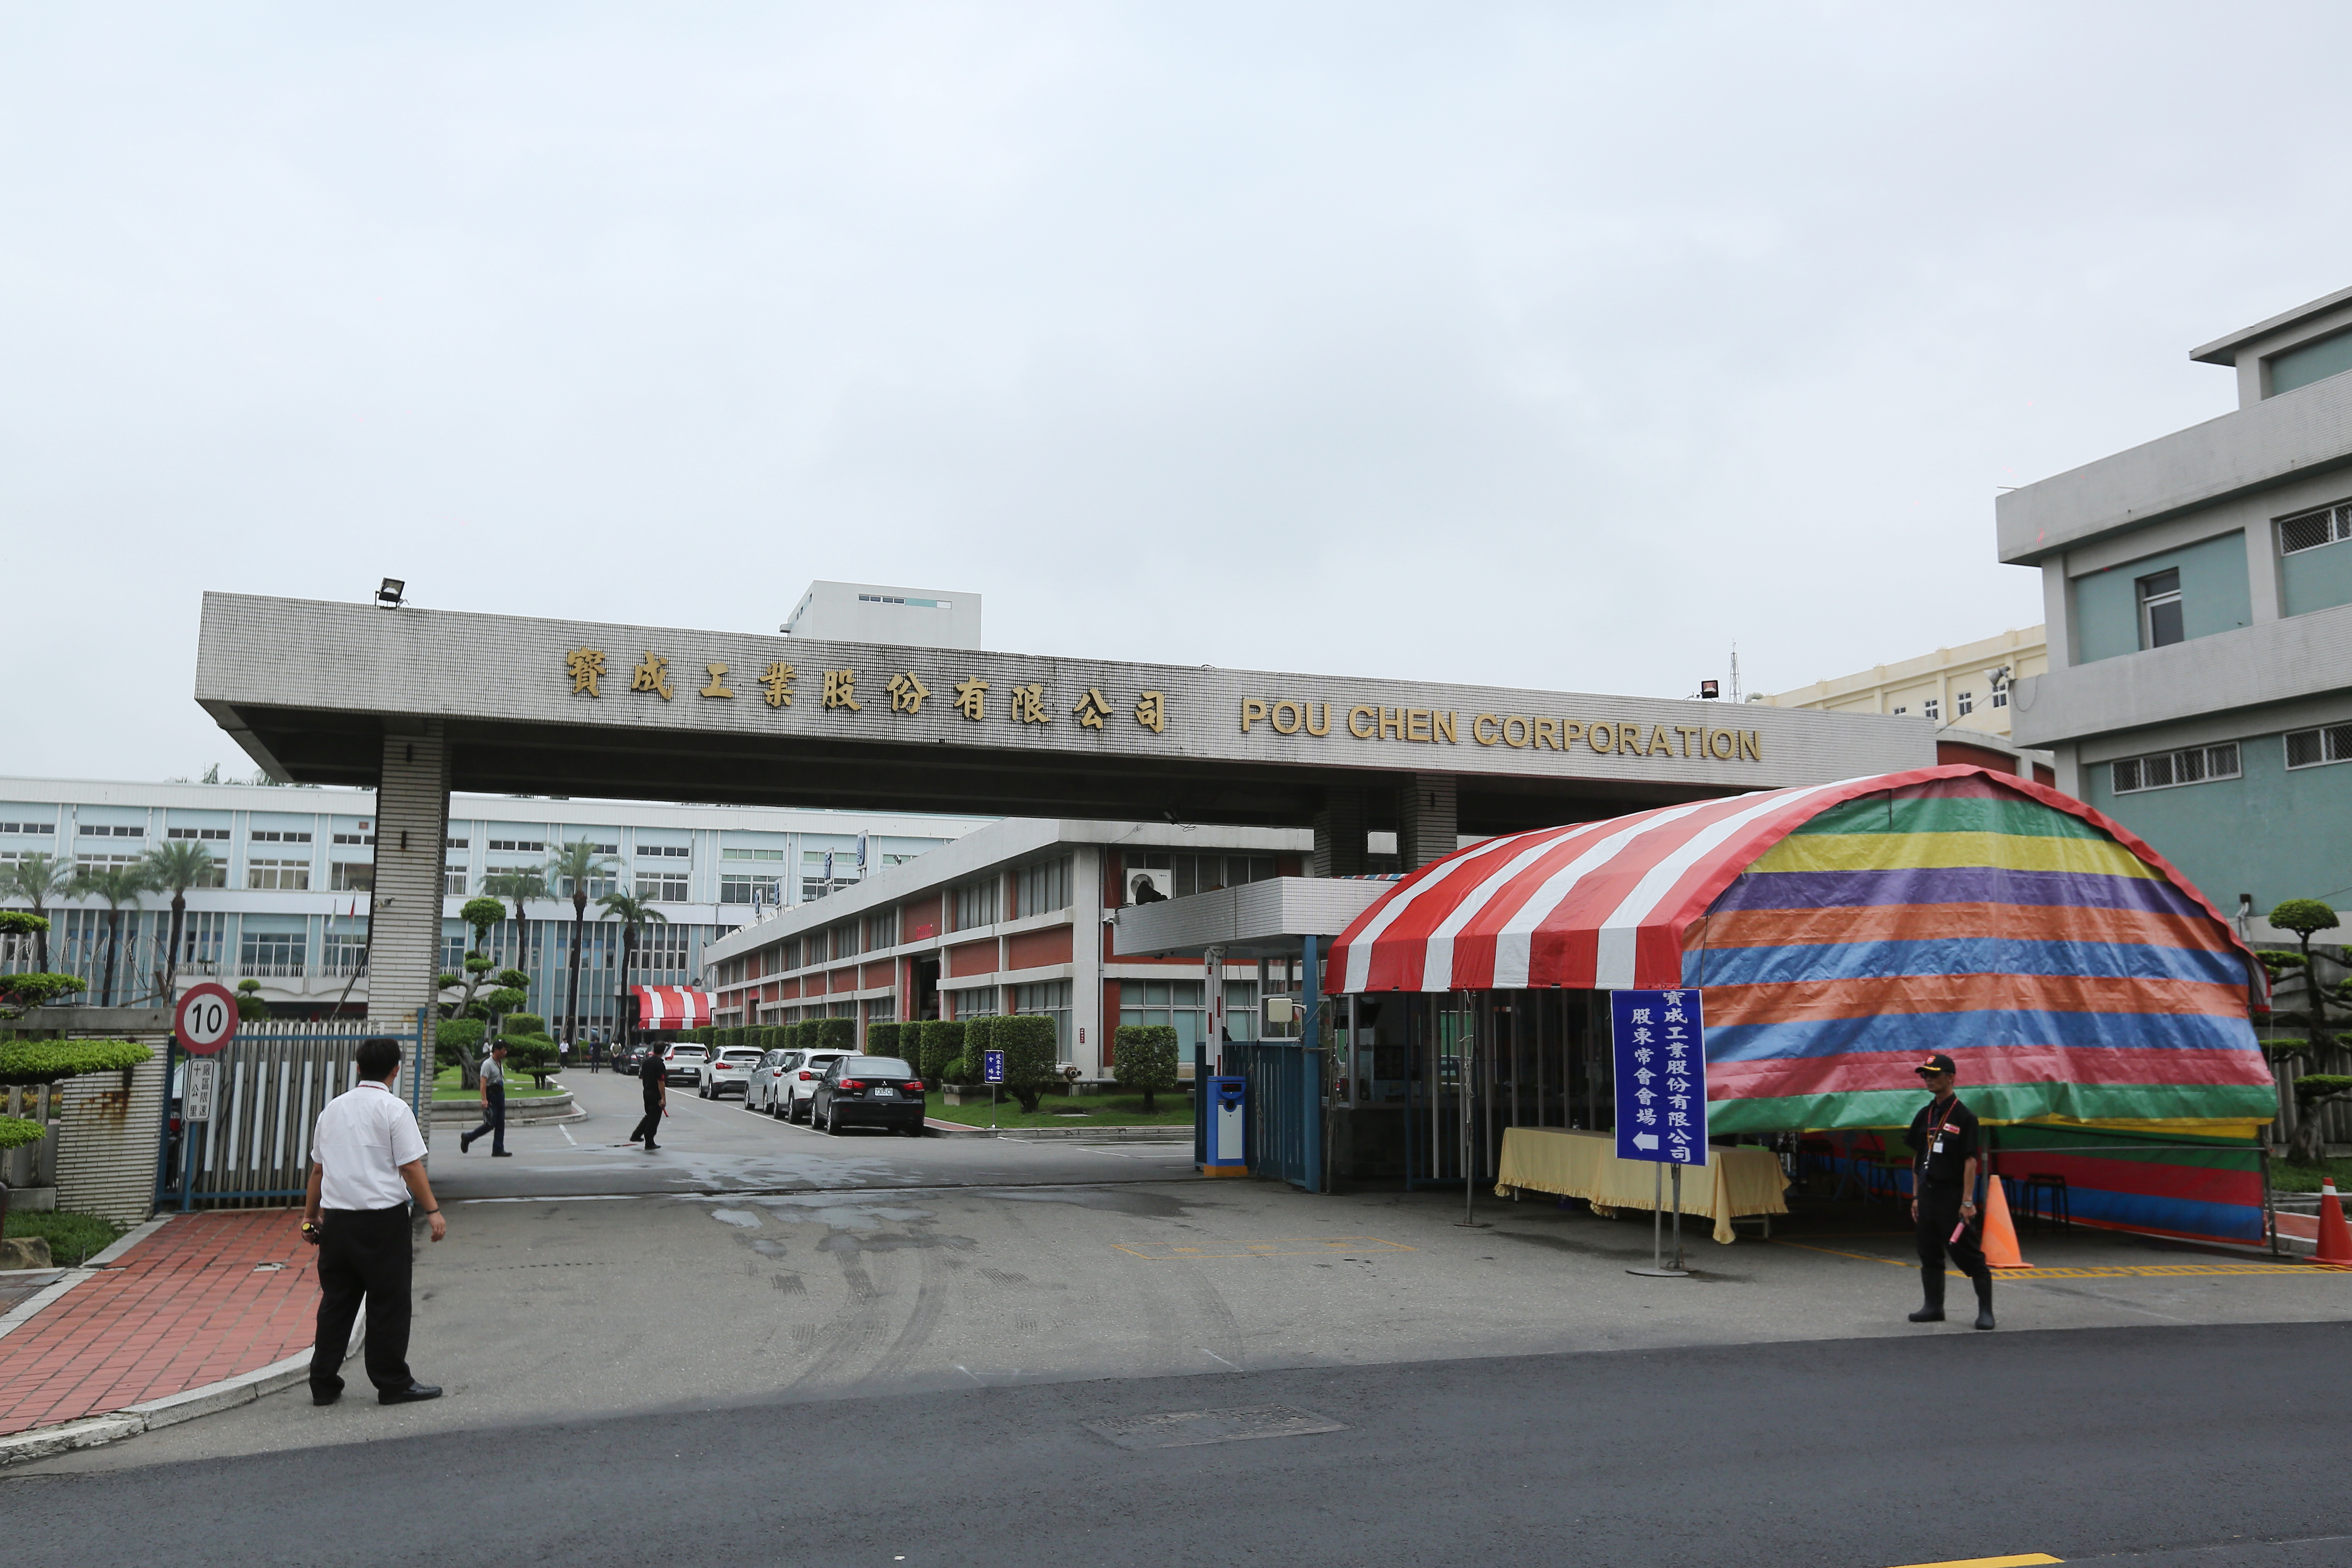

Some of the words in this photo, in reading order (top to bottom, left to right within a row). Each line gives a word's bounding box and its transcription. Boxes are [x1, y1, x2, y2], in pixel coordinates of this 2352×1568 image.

[567, 647, 1165, 733] 寶成工業股份有限公司
[1242, 699, 1331, 736] POU
[1348, 705, 1458, 743] CHEN
[1473, 713, 1762, 760] CORPORATION
[192, 1003, 222, 1033] 10
[189, 1063, 201, 1117] 十公里
[199, 1063, 211, 1116] 廠區限速
[1631, 1009, 1658, 1126] 股東常會會場
[1663, 991, 1692, 1163] 寶成工業股份有限公司
